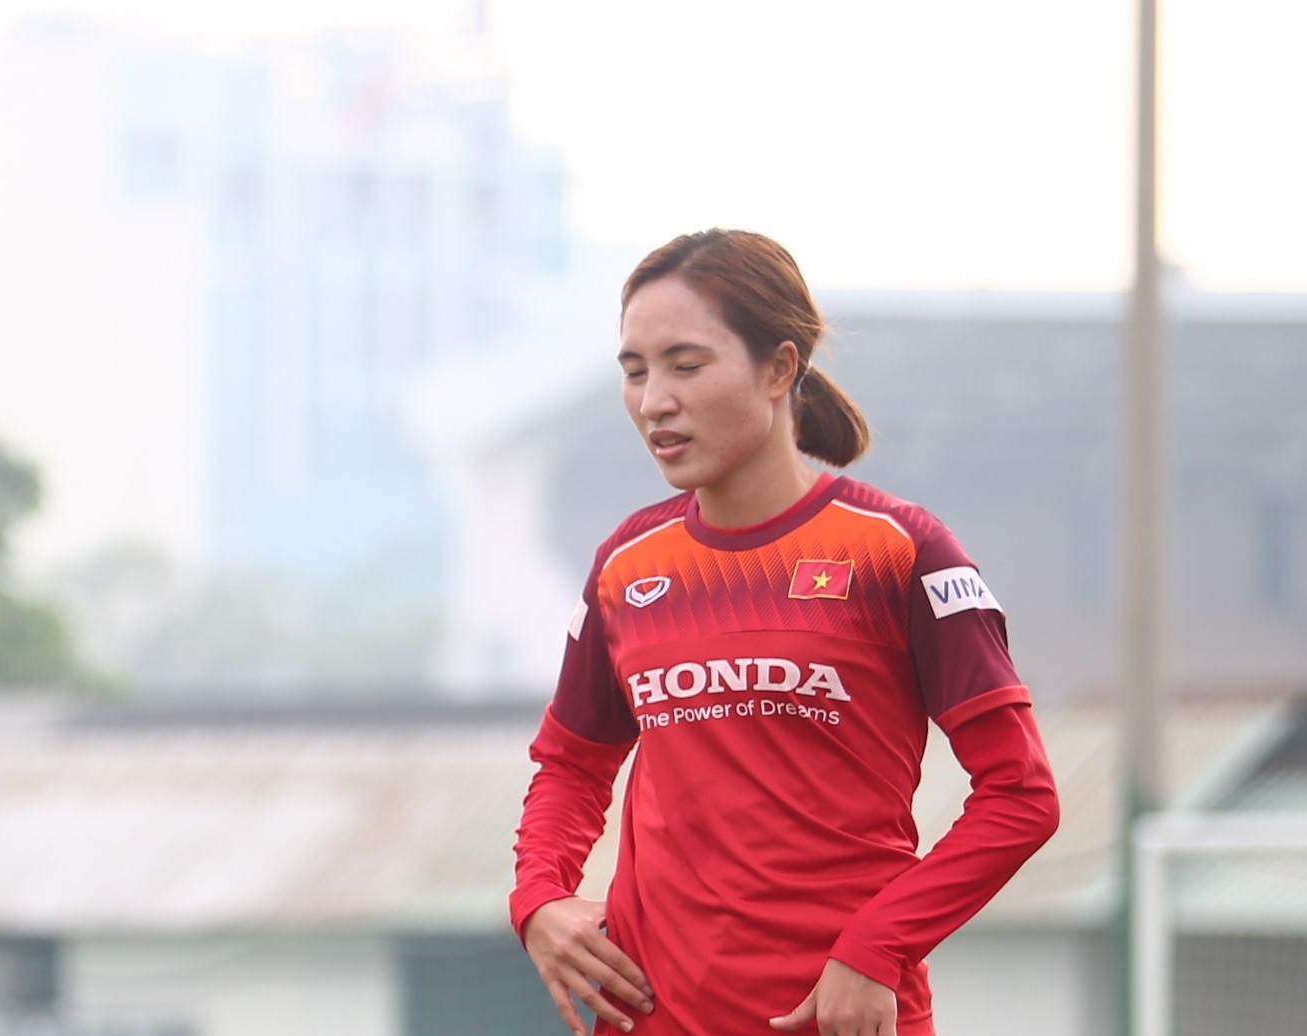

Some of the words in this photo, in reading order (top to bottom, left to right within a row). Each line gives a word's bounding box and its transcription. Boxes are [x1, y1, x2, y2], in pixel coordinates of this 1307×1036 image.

[627, 657, 851, 709] HONDA
[637, 713, 670, 732] The
[673, 703, 732, 723] Power
[735, 699, 755, 717] of
[760, 699, 840, 725] Dreams
